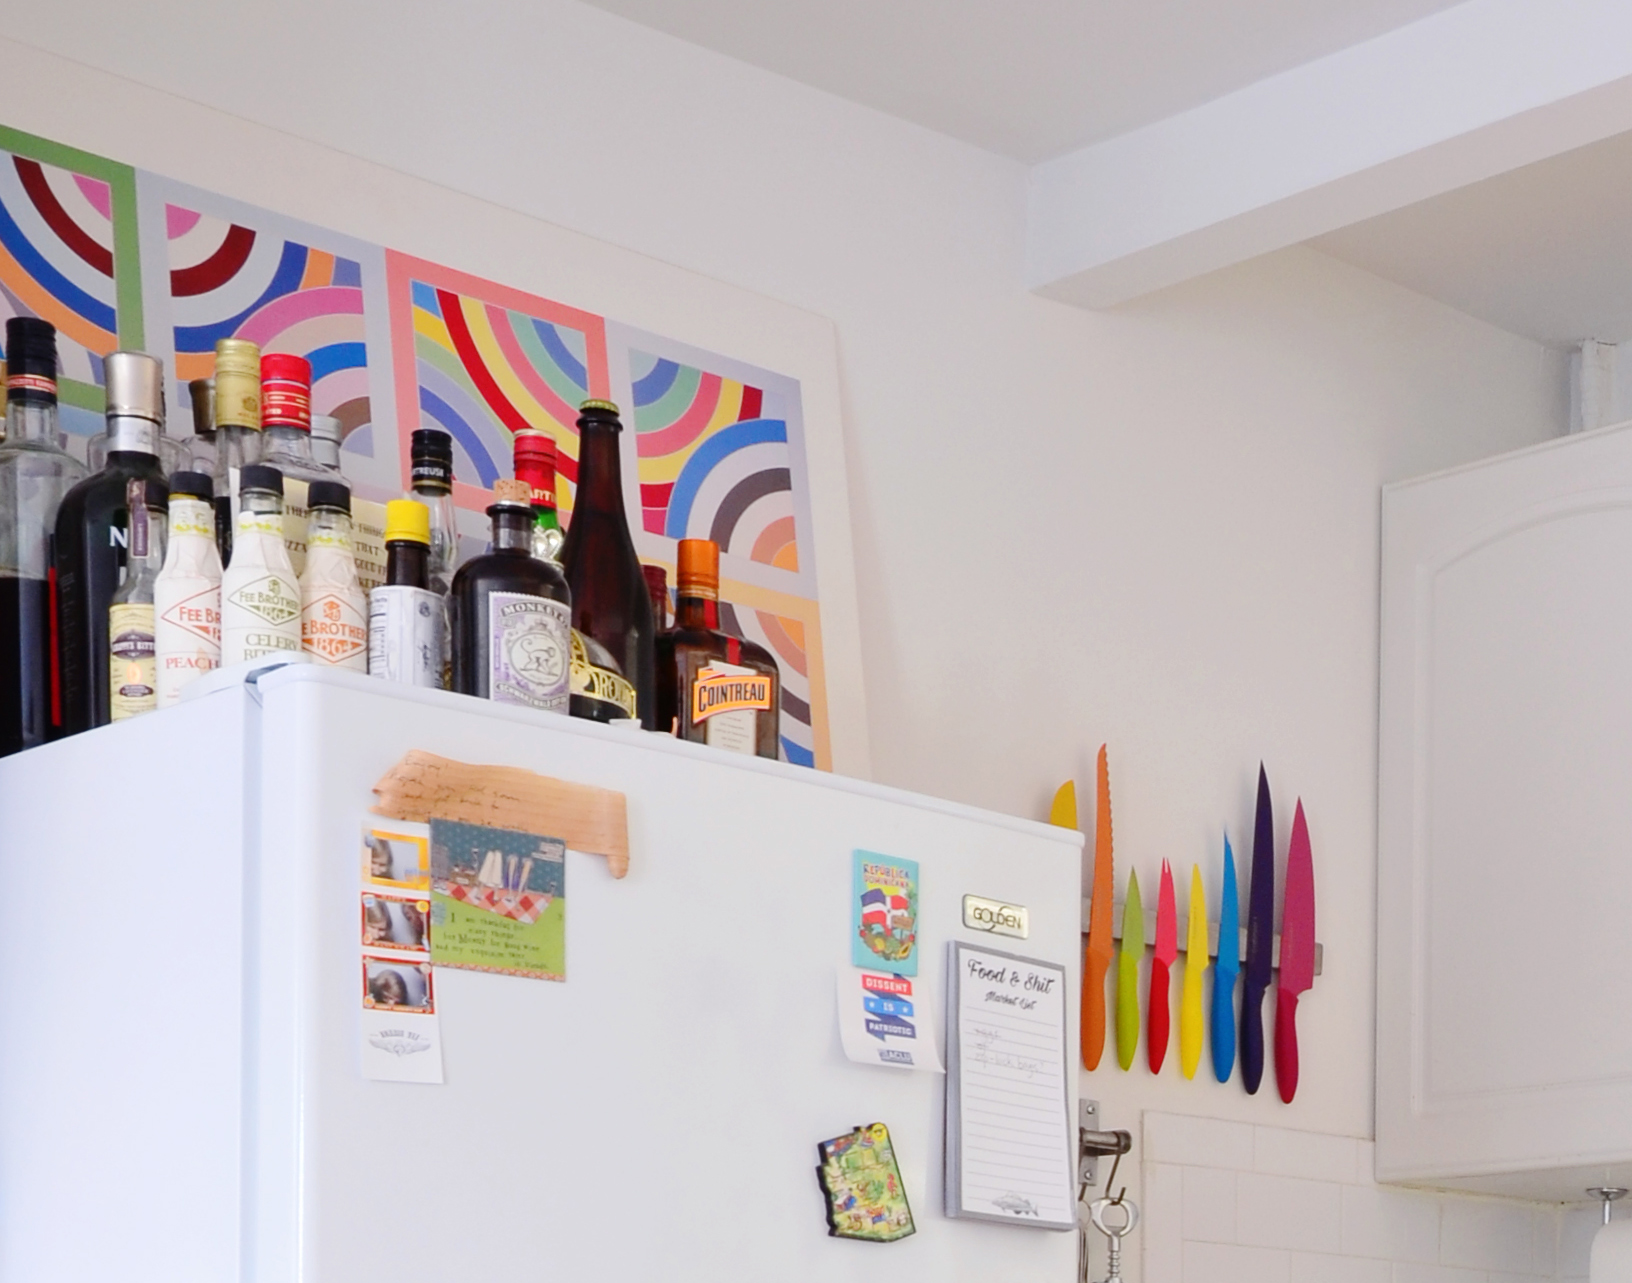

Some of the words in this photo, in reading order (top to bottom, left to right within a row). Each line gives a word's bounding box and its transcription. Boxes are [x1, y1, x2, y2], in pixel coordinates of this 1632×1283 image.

[239, 591, 257, 604] FEE
[179, 606, 204, 623] FEE
[315, 637, 354, 657] 1864
[165, 656, 219, 671] PEACH
[698, 682, 766, 713] COINTREAU
[967, 958, 1007, 984] Food
[1010, 971, 1022, 987] &
[1024, 973, 1056, 995] Shit
[866, 977, 909, 993] DISSENT
[883, 1001, 895, 1012] IS
[869, 1021, 913, 1036] PATRIOTIC
